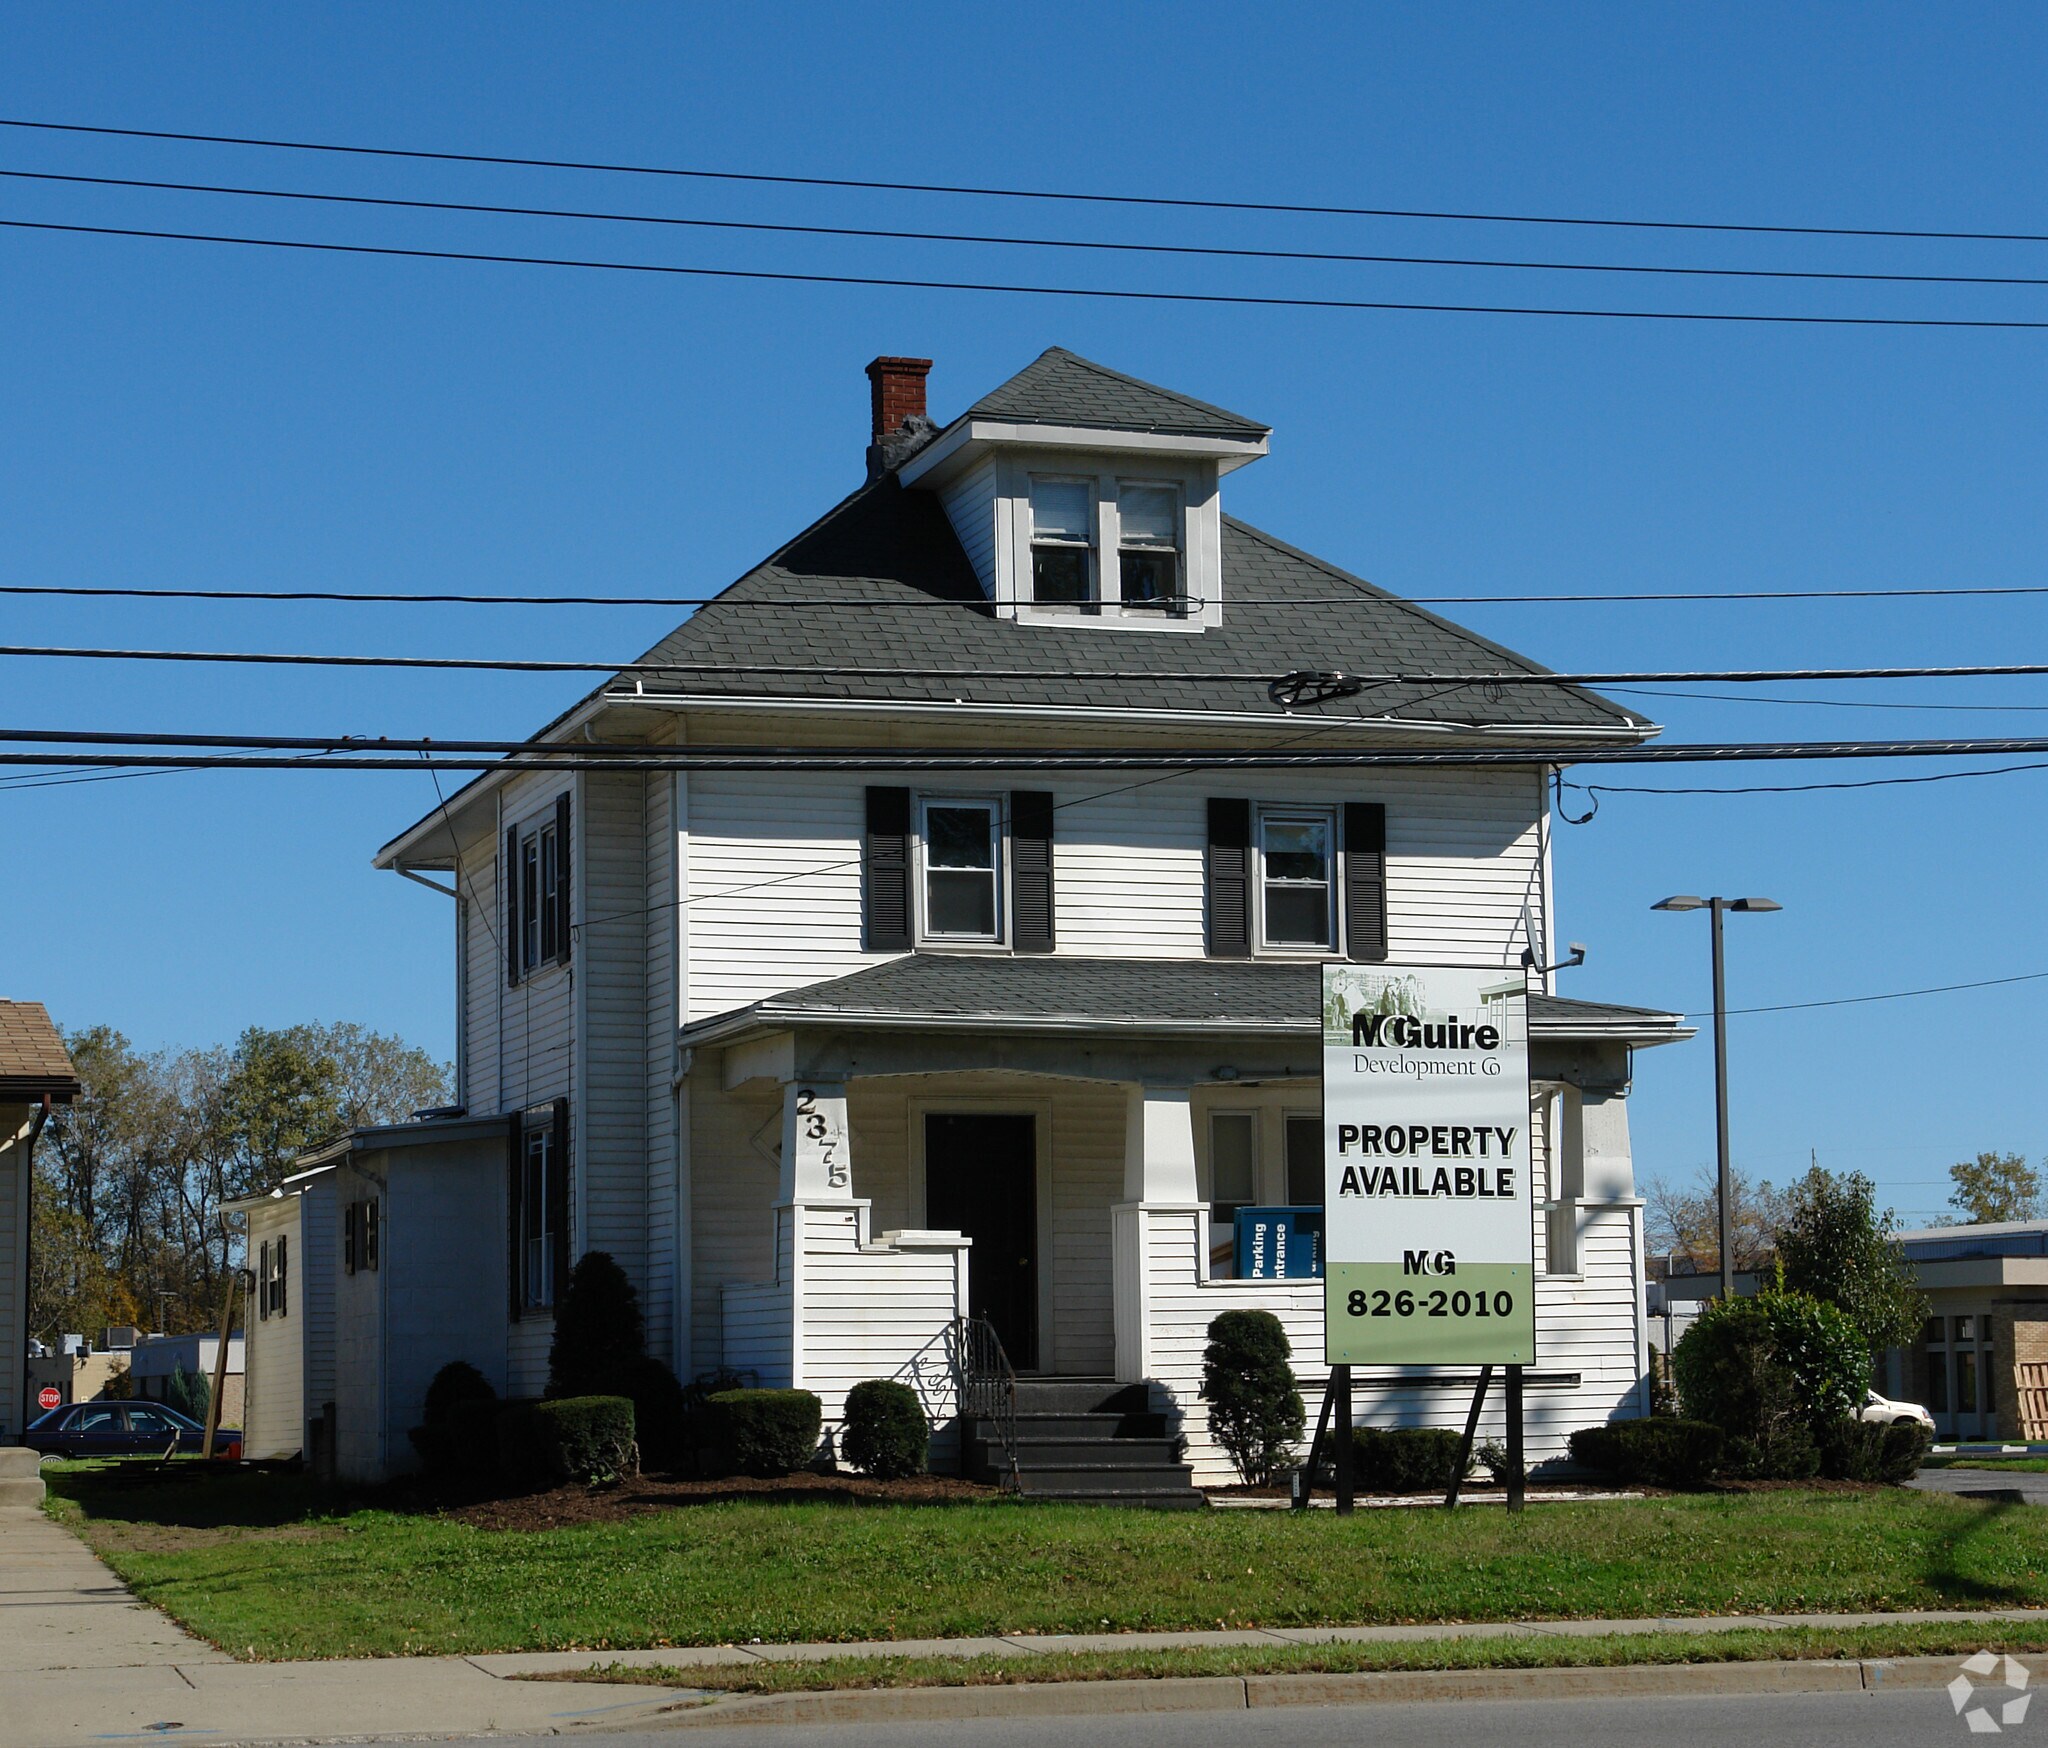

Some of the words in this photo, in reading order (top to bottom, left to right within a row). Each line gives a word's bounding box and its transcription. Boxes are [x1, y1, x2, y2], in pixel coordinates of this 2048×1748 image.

[1353, 1053, 1476, 1080] Development
[797, 1089, 848, 1188] 2375
[1338, 1124, 1517, 1158] PROPERTY
[1339, 1165, 1517, 1200] AVAILABLE
[1252, 1223, 1267, 1278] Parking
[1274, 1223, 1286, 1279] ntrance
[1347, 1289, 1513, 1317] 826-2010
[41, 1394, 59, 1402] STOP
